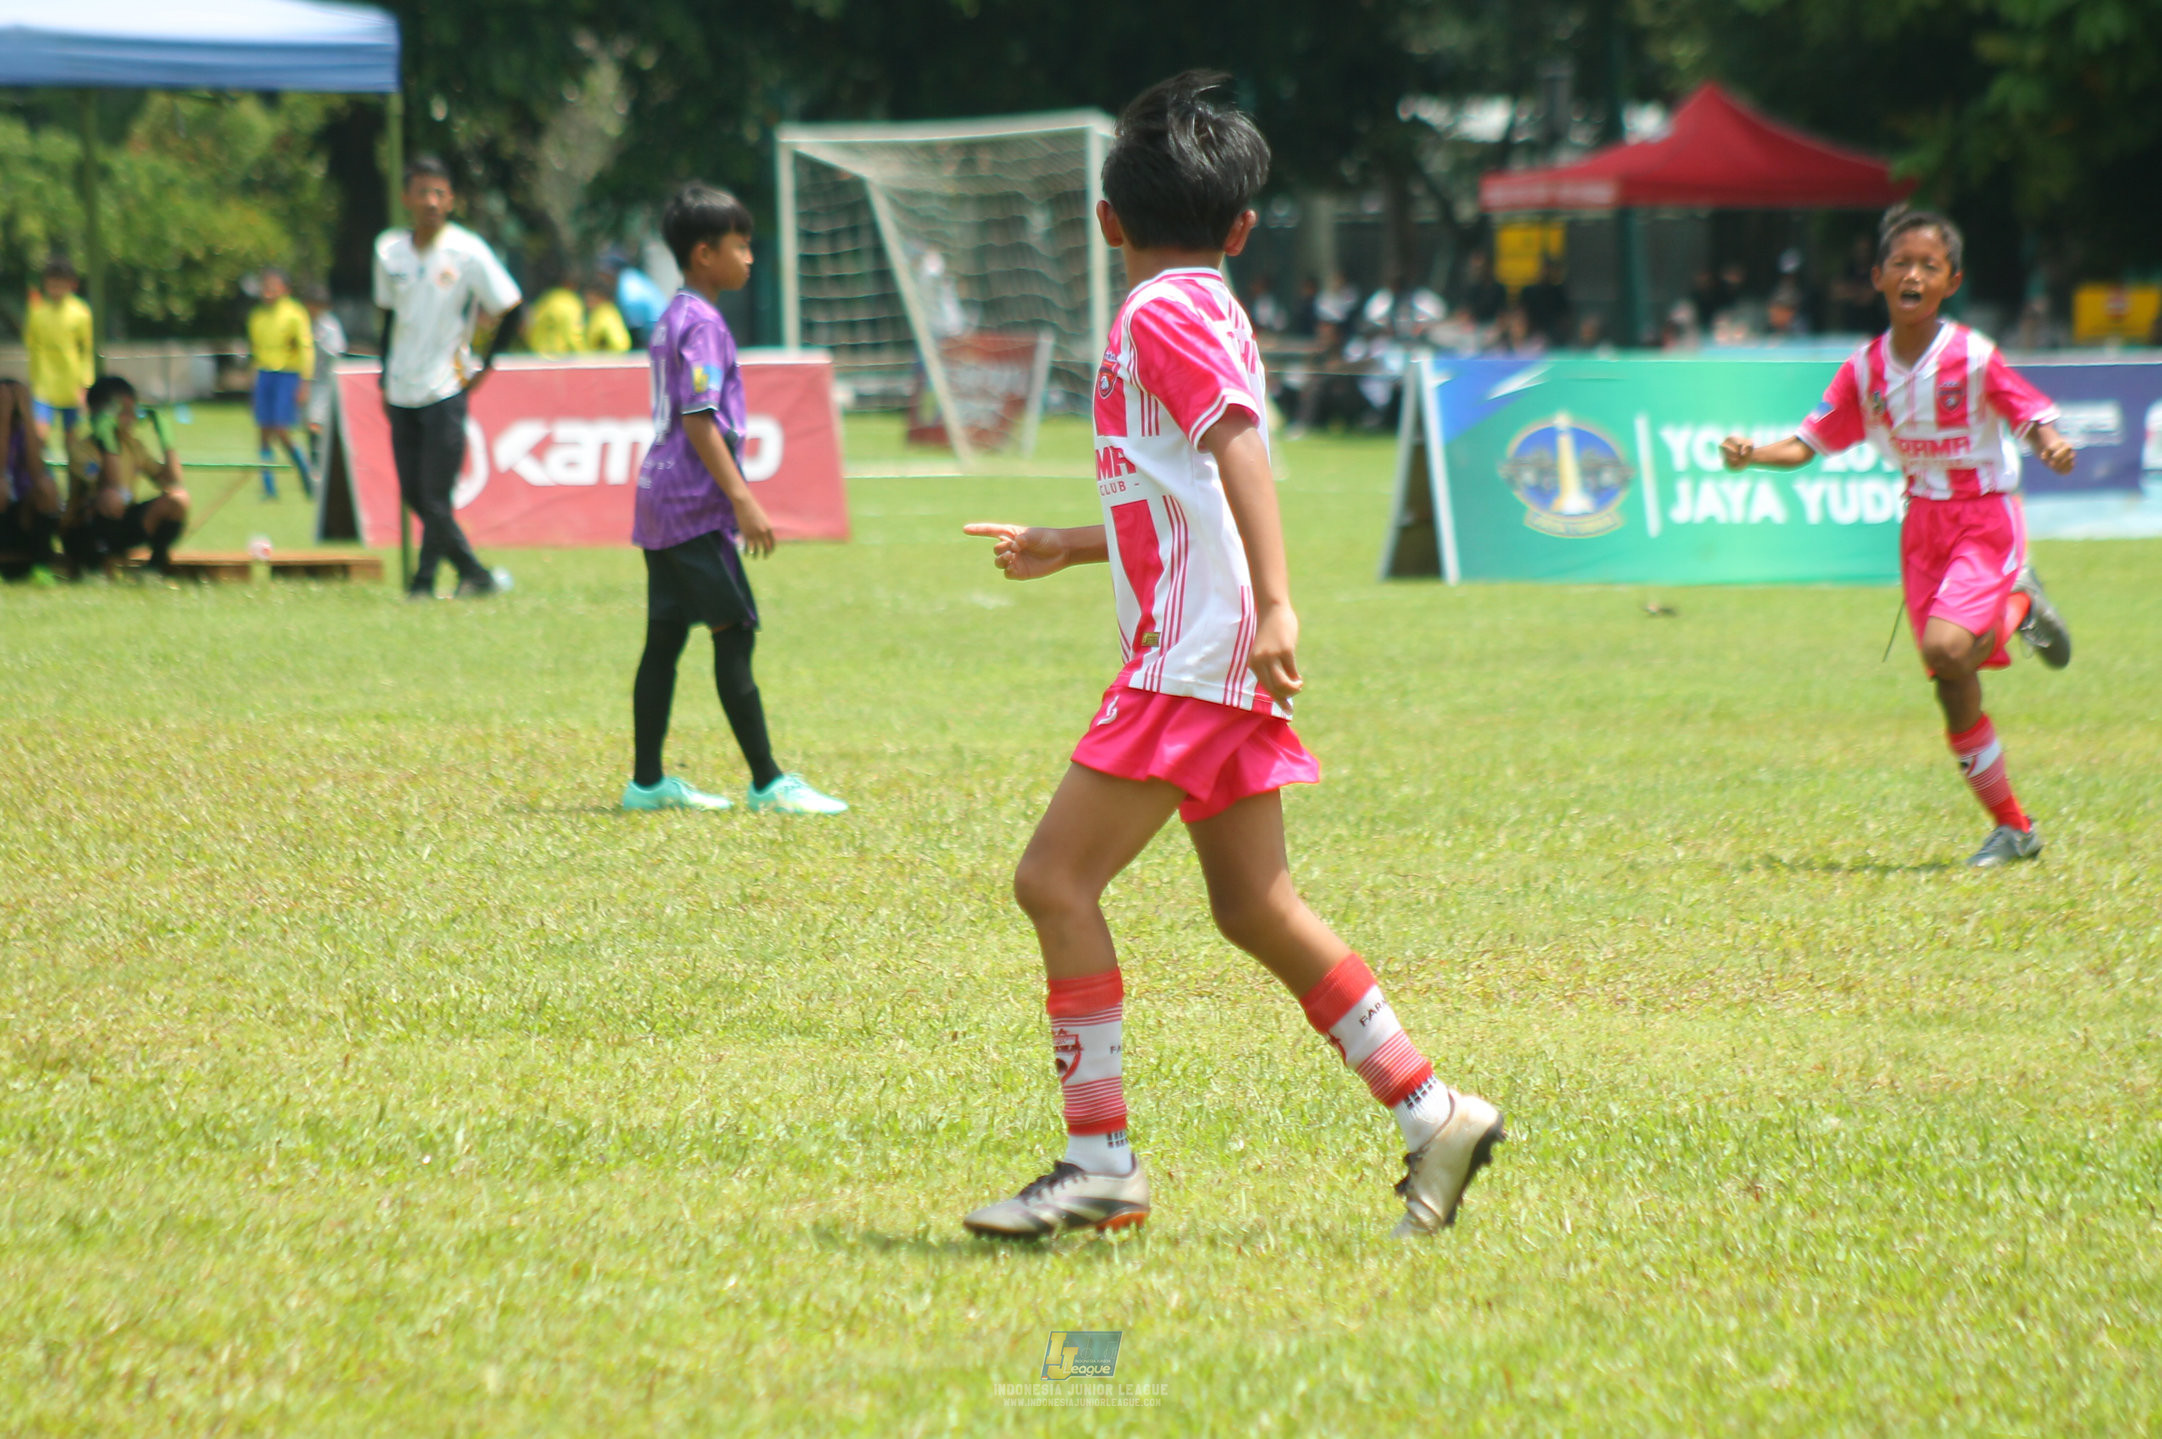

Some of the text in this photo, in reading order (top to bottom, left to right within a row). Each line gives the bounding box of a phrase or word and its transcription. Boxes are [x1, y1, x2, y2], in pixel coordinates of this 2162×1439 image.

[495, 416, 784, 486] kamo
[1095, 446, 1136, 481] MA
[1671, 479, 1786, 524] JAYA
